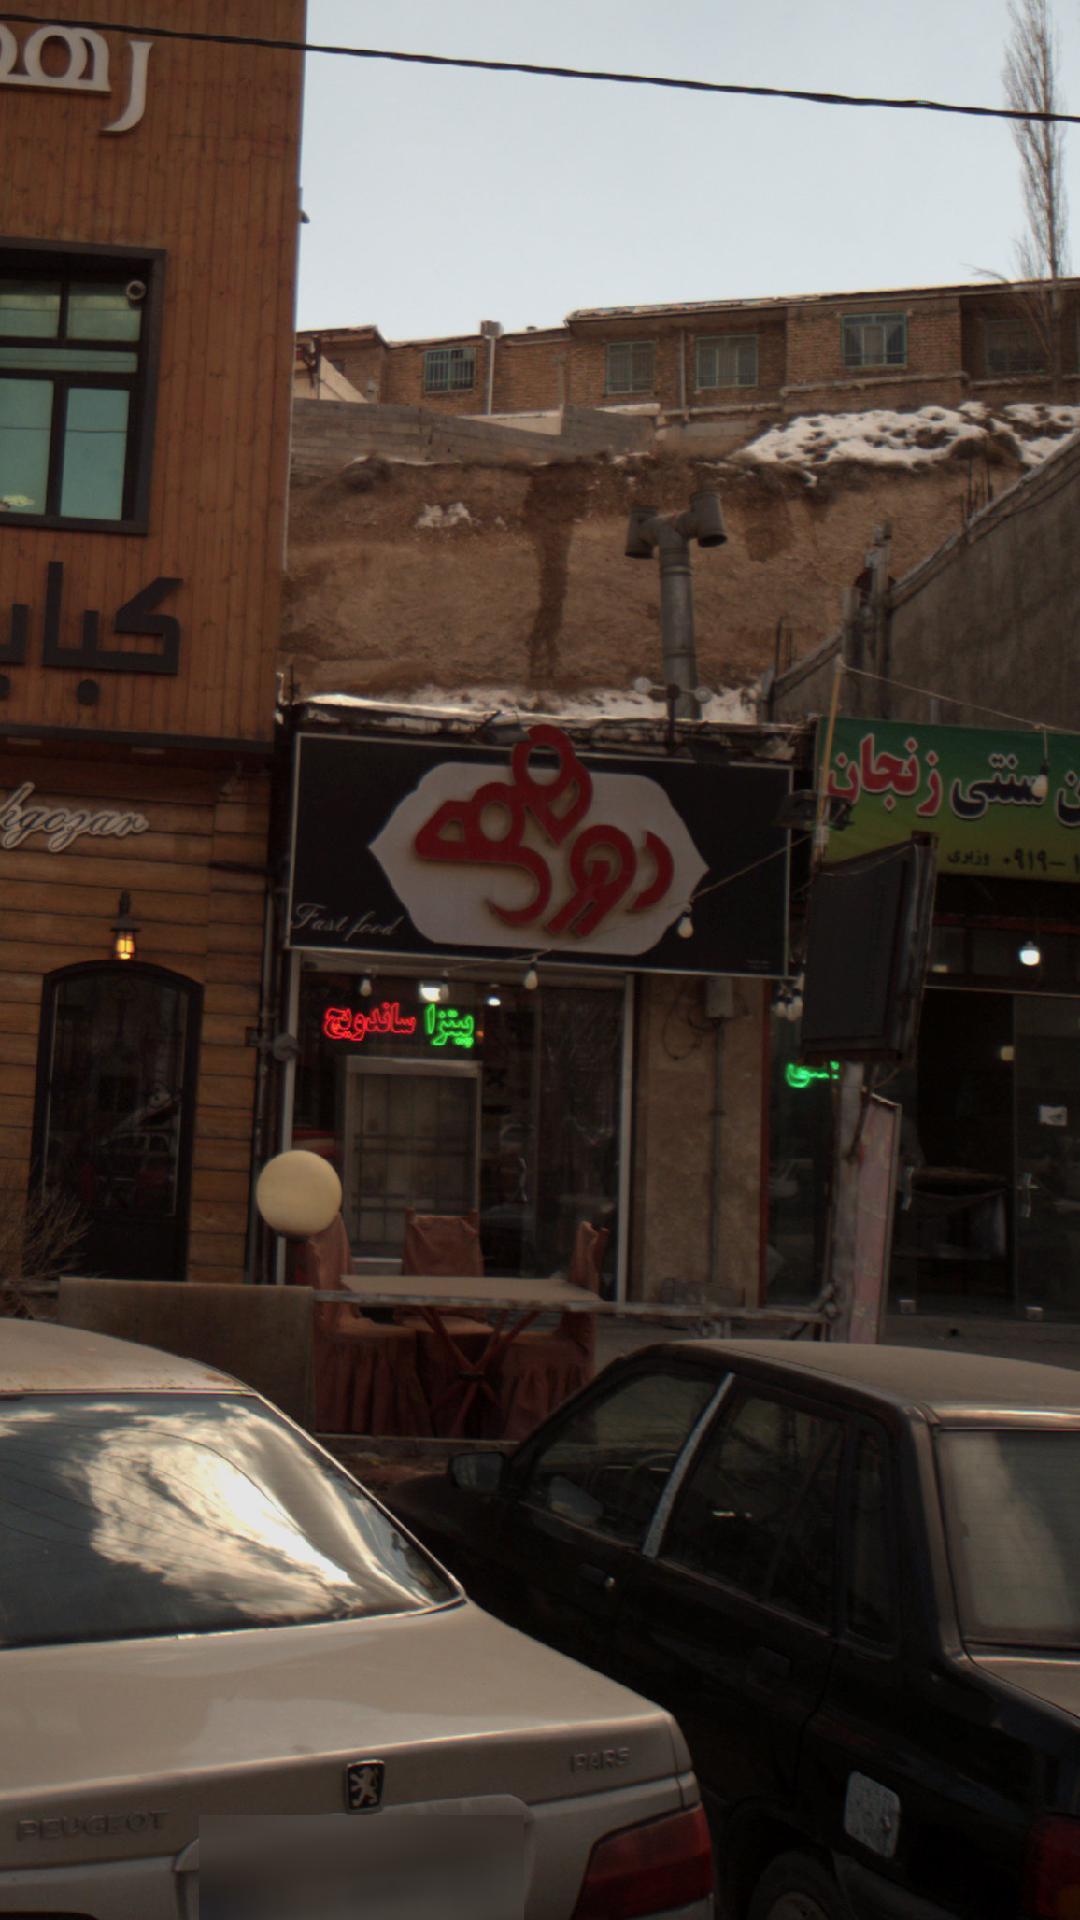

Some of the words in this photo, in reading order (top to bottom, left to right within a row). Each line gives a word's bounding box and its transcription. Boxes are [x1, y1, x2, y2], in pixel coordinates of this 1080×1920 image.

[826, 732, 944, 818] زنجان
[950, 752, 1047, 819] سنتی
[291, 902, 349, 933] Fast
[343, 909, 406, 942] food
[322, 1001, 416, 1041] ساندویچ
[424, 1002, 475, 1048] پیتزا
[569, 1746, 631, 1773] PARS
[16, 1810, 170, 1843] PEUGEOT
